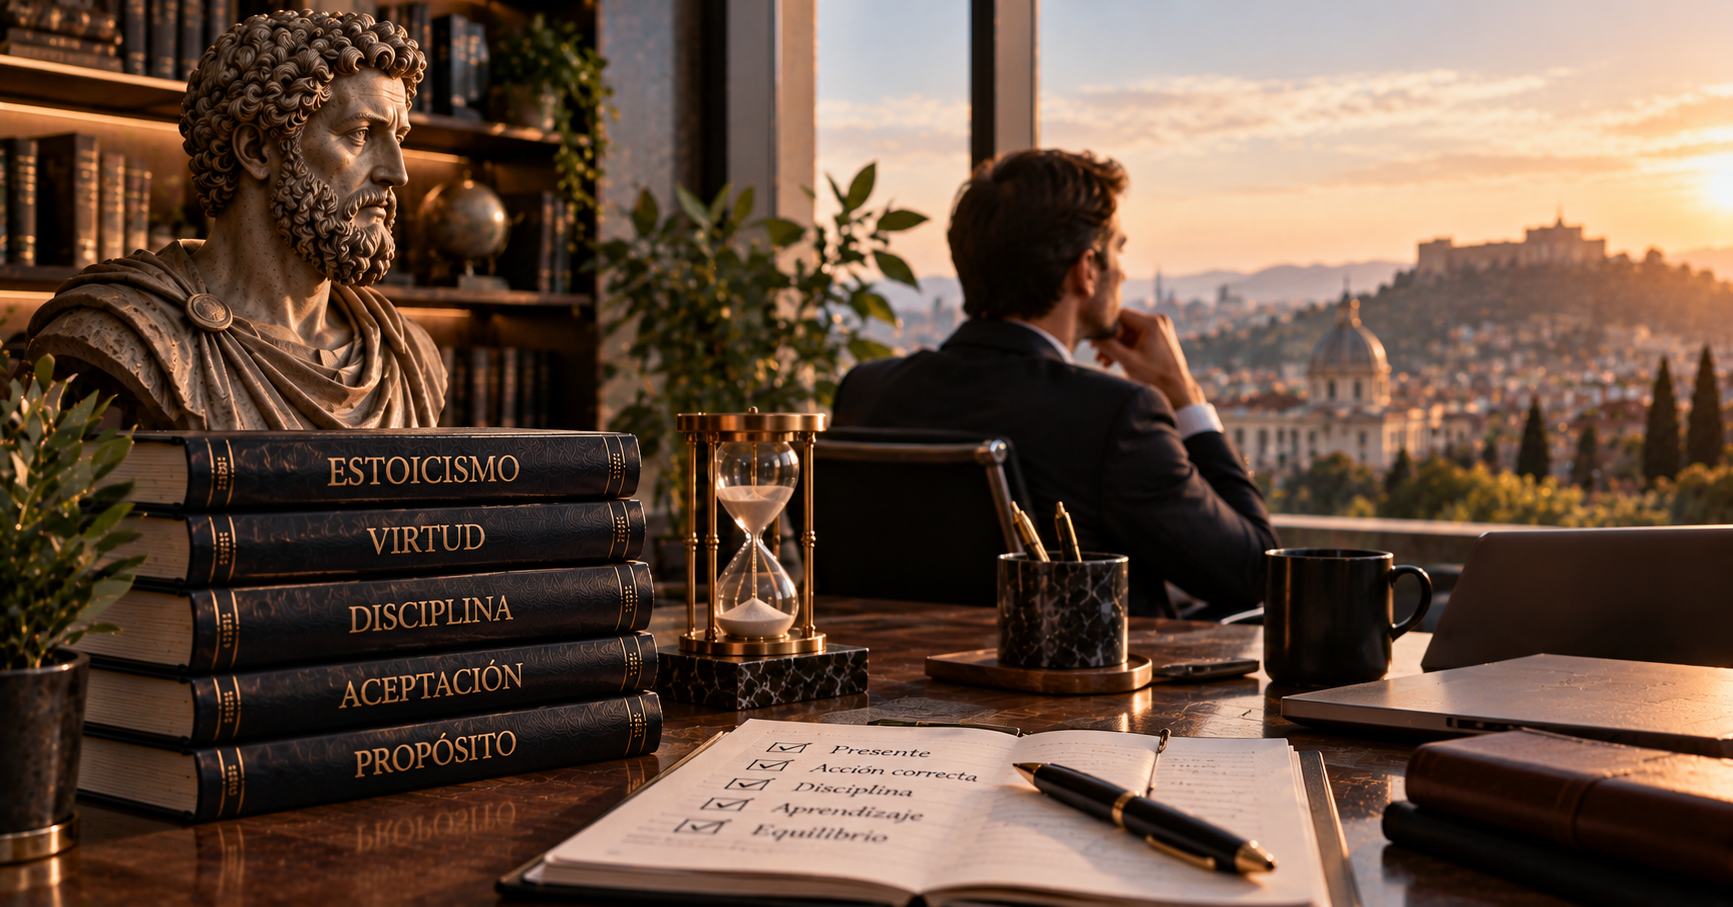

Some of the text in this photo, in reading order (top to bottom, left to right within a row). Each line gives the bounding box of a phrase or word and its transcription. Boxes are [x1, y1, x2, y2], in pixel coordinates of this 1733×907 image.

[327, 454, 520, 487] ESTOICISMO
[367, 523, 486, 555] VIRTUD
[349, 594, 514, 634] DISCIPLINA
[340, 660, 523, 708] ACEPTACIÓN
[354, 729, 517, 778] PROPÓSITO
[829, 745, 931, 758] Presente
[809, 763, 978, 783] Acción correcta
[791, 782, 913, 798] Disciplina
[770, 802, 924, 823] Aprendizaje
[751, 823, 889, 842] Equilibrio
